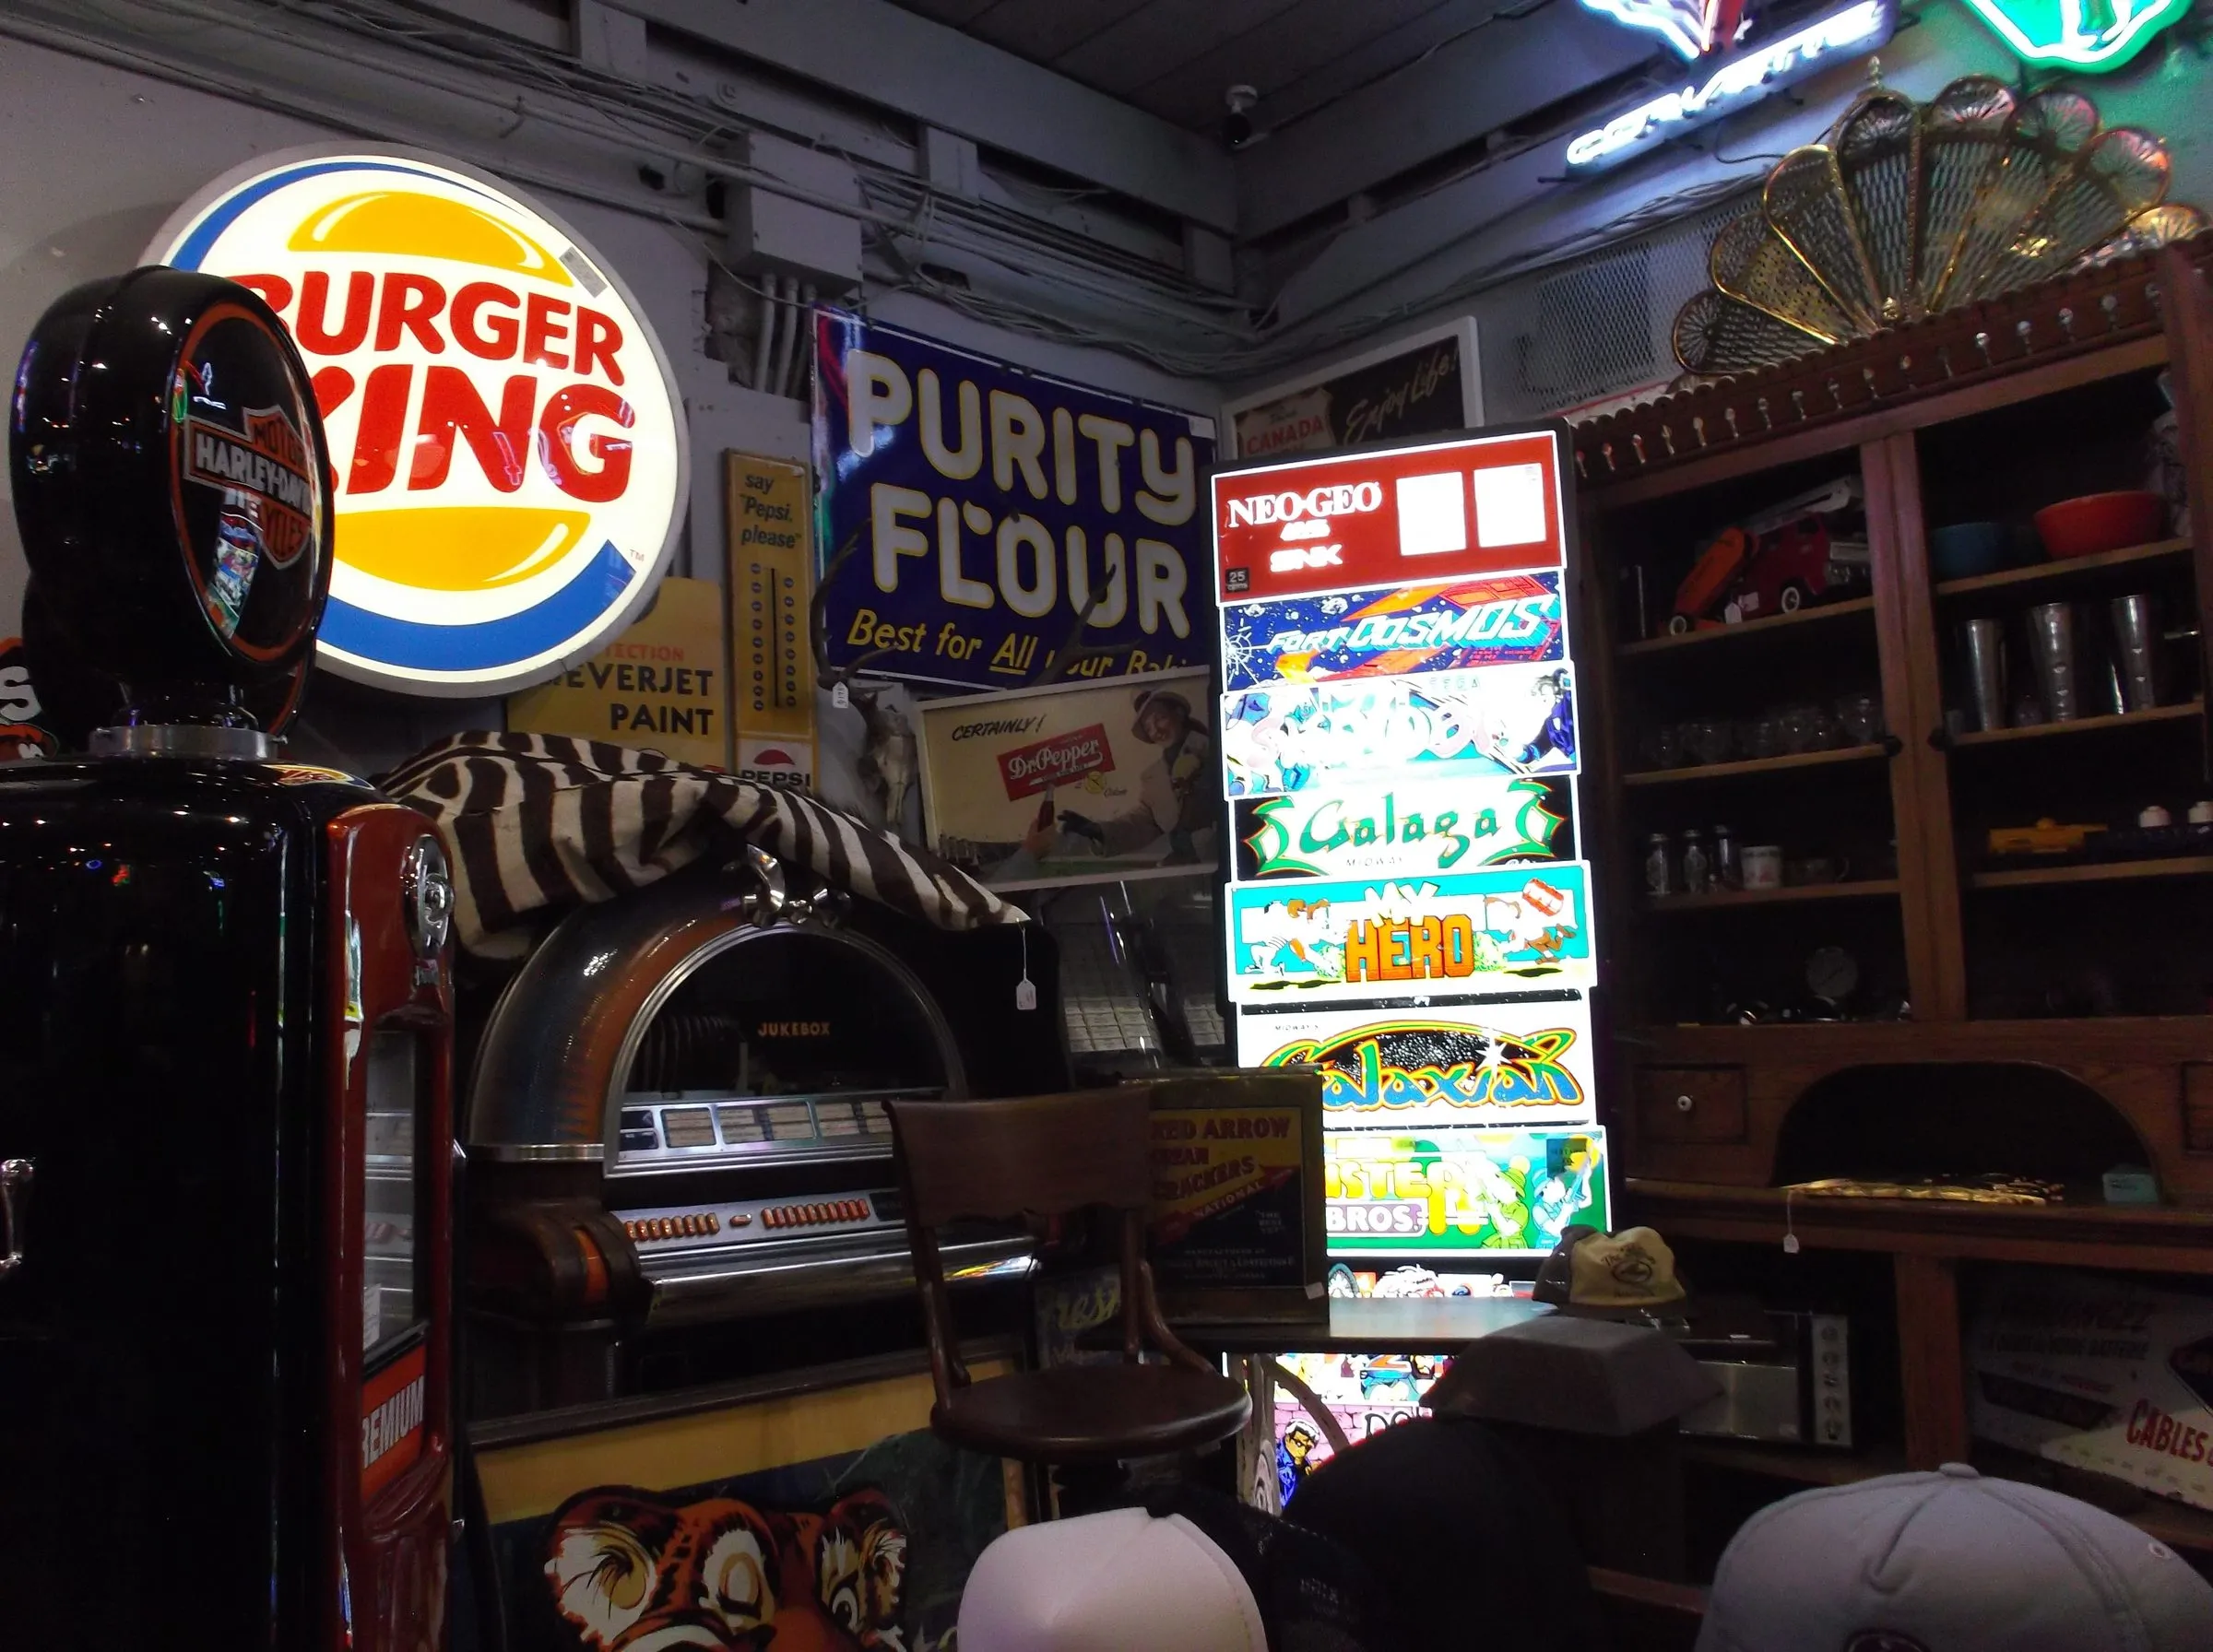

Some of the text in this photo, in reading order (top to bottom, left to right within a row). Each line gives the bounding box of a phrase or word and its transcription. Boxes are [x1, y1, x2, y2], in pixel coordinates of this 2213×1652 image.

[1343, 381, 1411, 444] Enjoy
[846, 348, 1198, 526] PURITY
[1247, 415, 1323, 454] CANADA
[744, 472, 774, 495] say
[870, 481, 1192, 639] FLOUR
[1229, 571, 1245, 583] 25
[1344, 594, 1560, 650] COSMOS
[847, 608, 927, 654] Best
[934, 621, 983, 661] for
[990, 631, 1039, 676] All
[550, 661, 713, 696] EVERJET
[610, 703, 714, 736] PAINT
[952, 714, 1047, 743] CERTAINLY!
[1035, 739, 1100, 773] Pepper
[741, 770, 811, 787] PEPSI
[1299, 792, 1501, 869] Galaga
[1364, 880, 1440, 928] MY
[1345, 914, 1475, 983] HERO
[756, 1021, 831, 1037] JUKEBOX
[1201, 1115, 1290, 1139] ARROW
[1326, 1205, 1421, 1233] BROS.
[2125, 1398, 2209, 1462] CABLES
